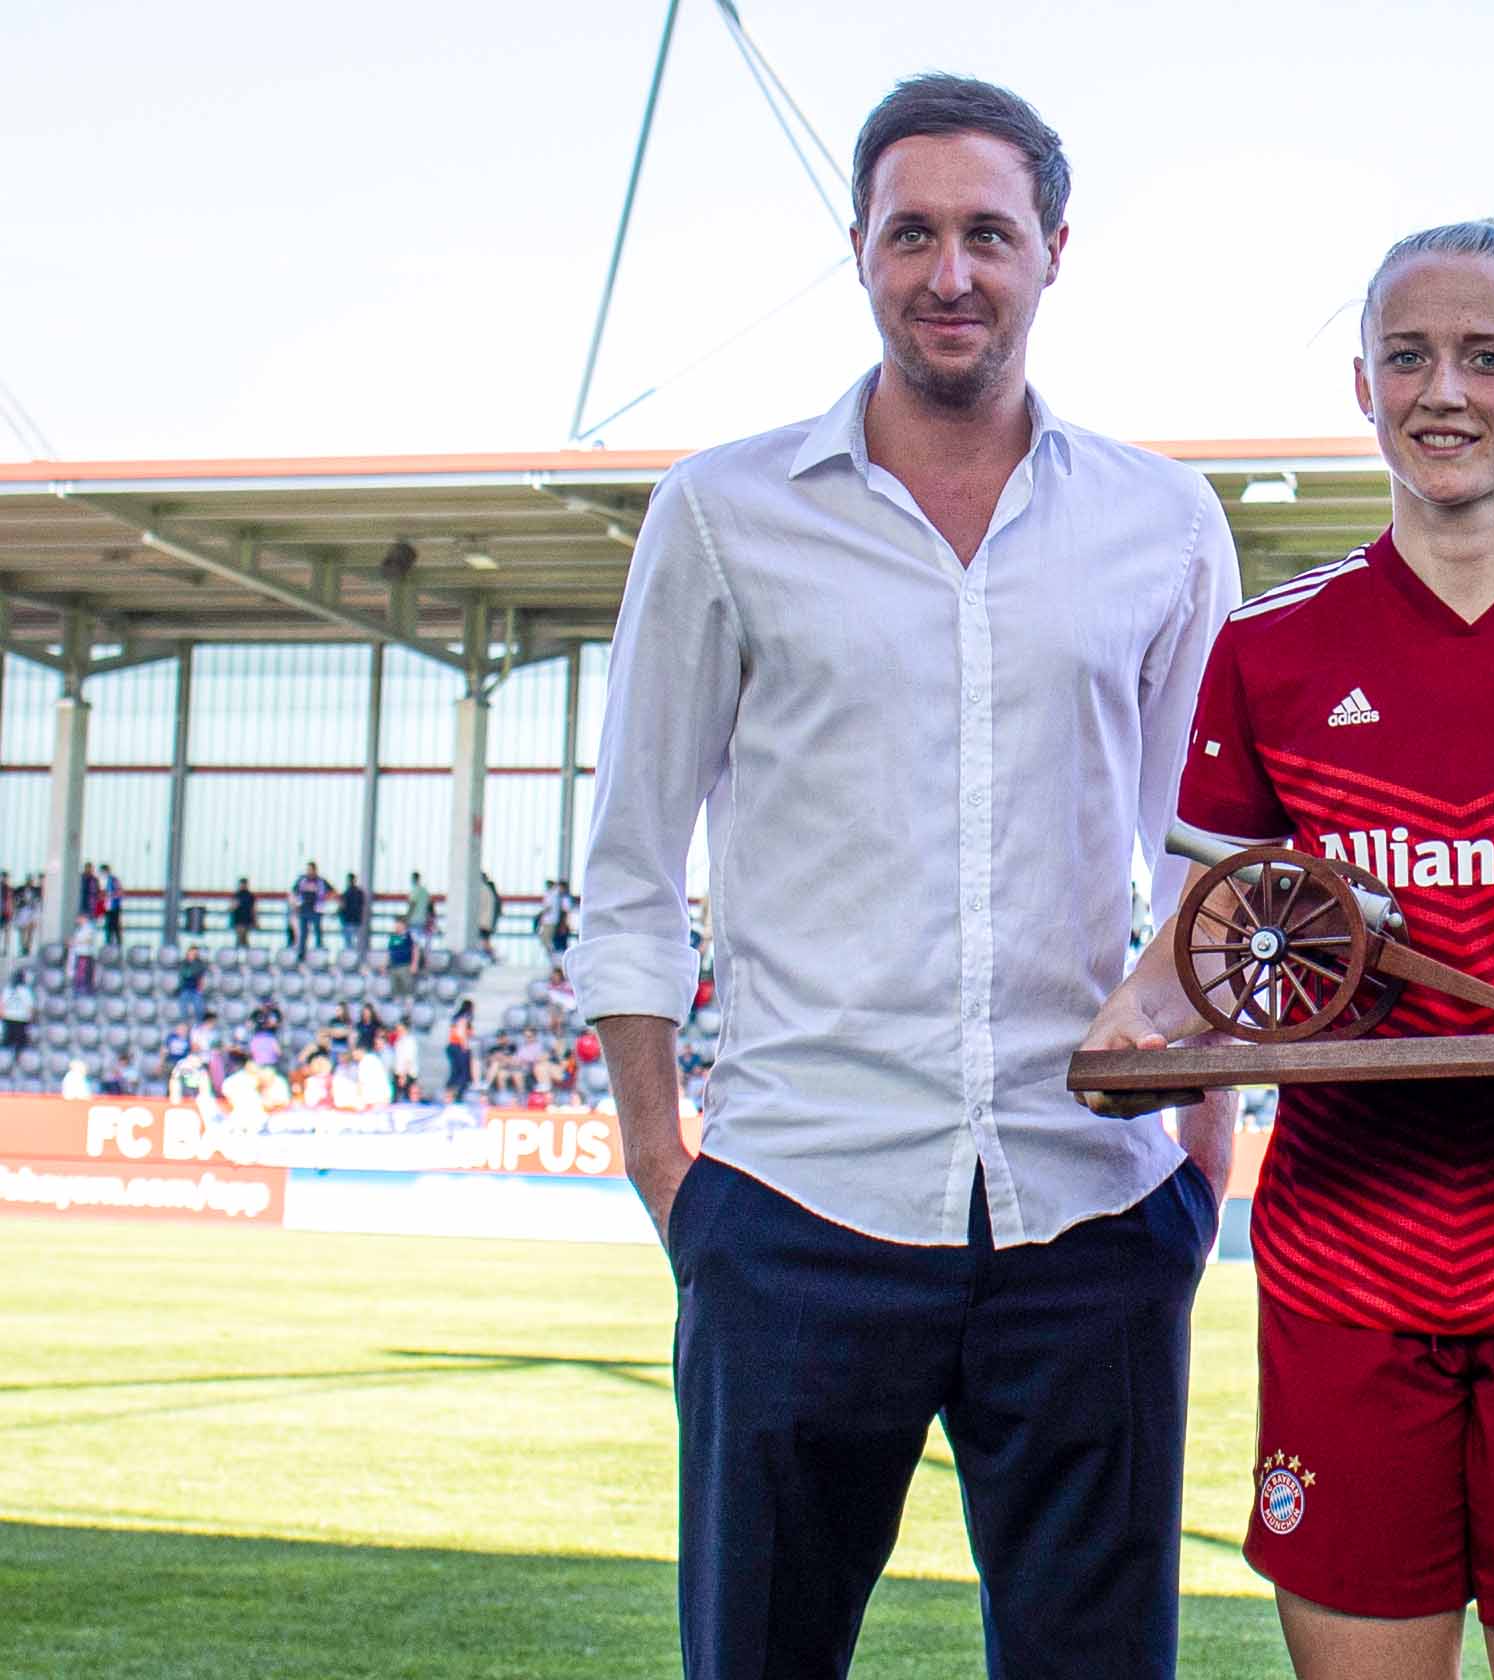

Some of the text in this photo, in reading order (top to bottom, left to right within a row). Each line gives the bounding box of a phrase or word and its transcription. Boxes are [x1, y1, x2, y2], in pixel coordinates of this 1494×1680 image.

[1327, 708, 1380, 727] adidas
[86, 1105, 154, 1158] FC
[1271, 1474, 1300, 1497] BAYERN
